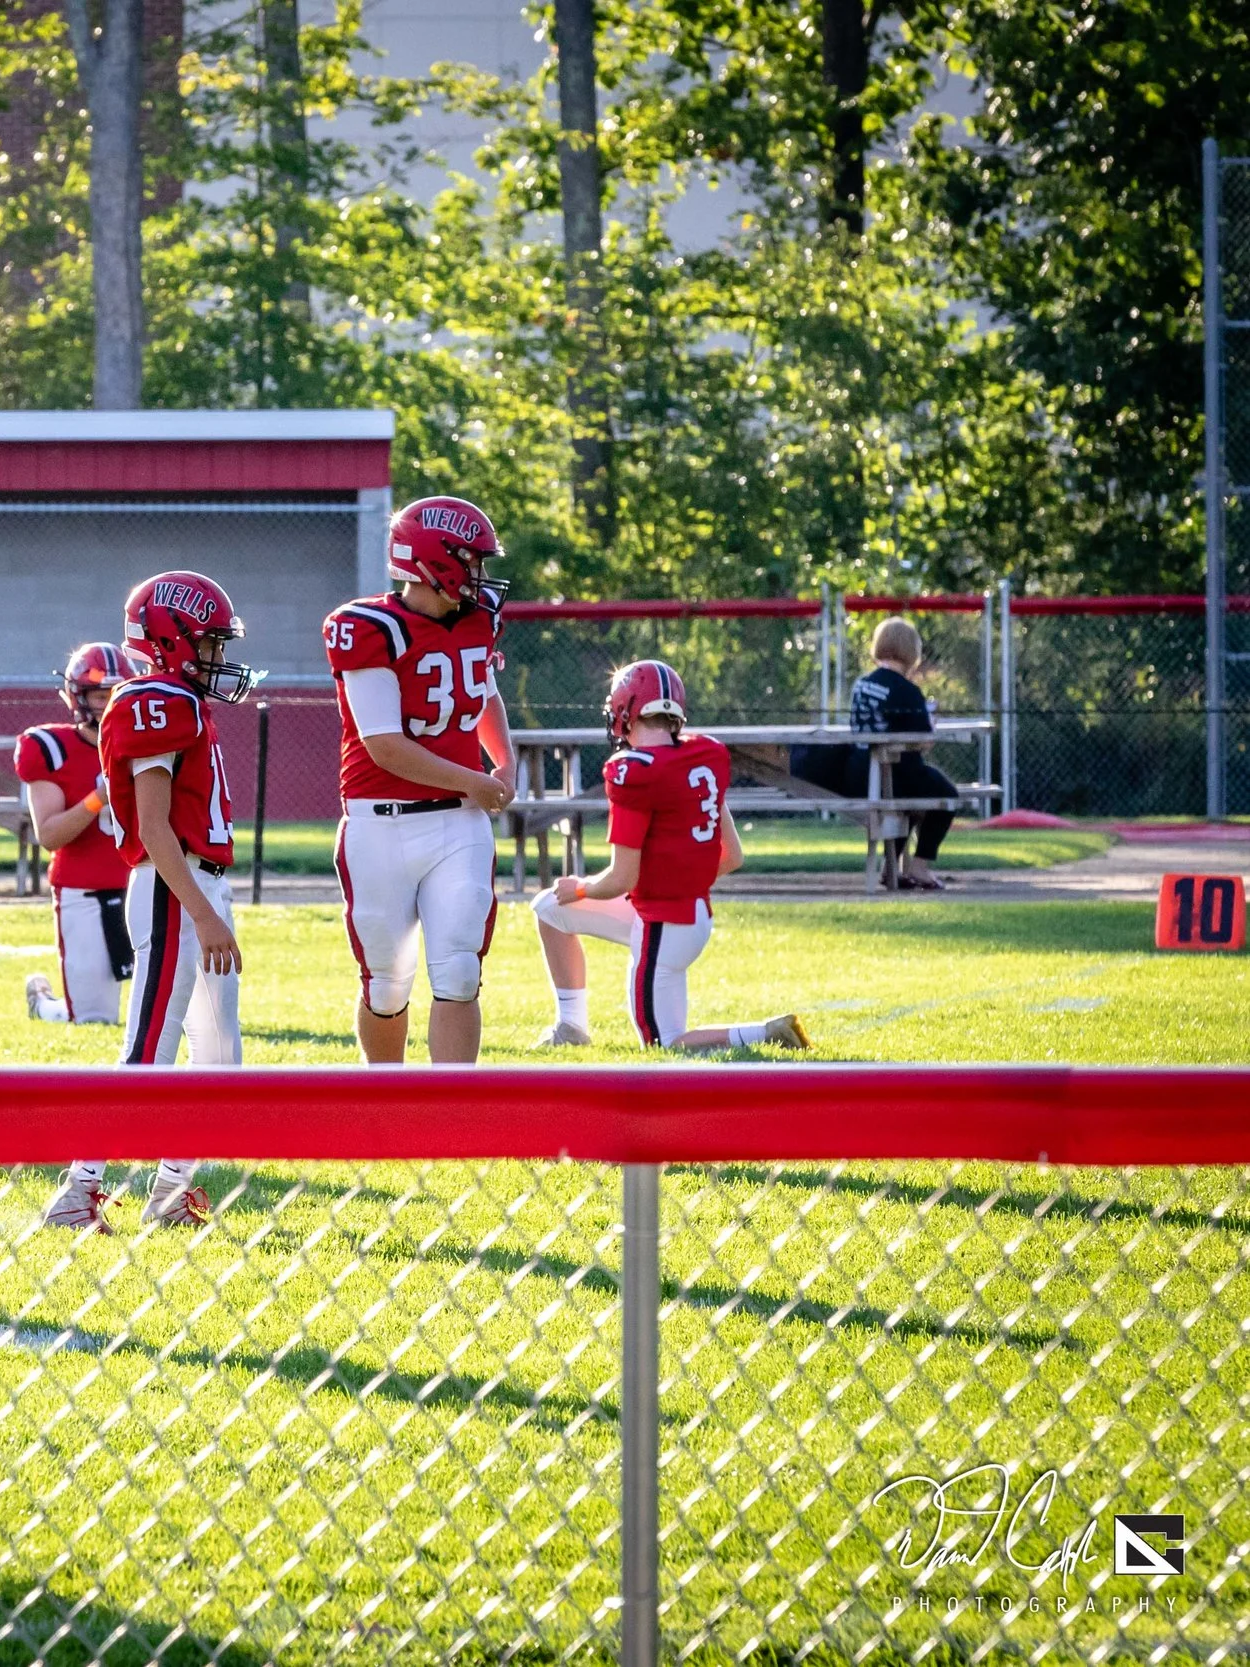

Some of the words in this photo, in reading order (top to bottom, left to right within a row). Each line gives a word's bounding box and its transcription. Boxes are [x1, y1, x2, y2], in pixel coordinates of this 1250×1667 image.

[422, 507, 481, 544] WELLS
[154, 581, 217, 625] WELLS
[325, 620, 355, 651] 35
[409, 646, 488, 737] 35
[131, 699, 168, 731] 15
[613, 763, 629, 786] 3
[688, 765, 720, 843] 3
[1173, 877, 1236, 944] 10
